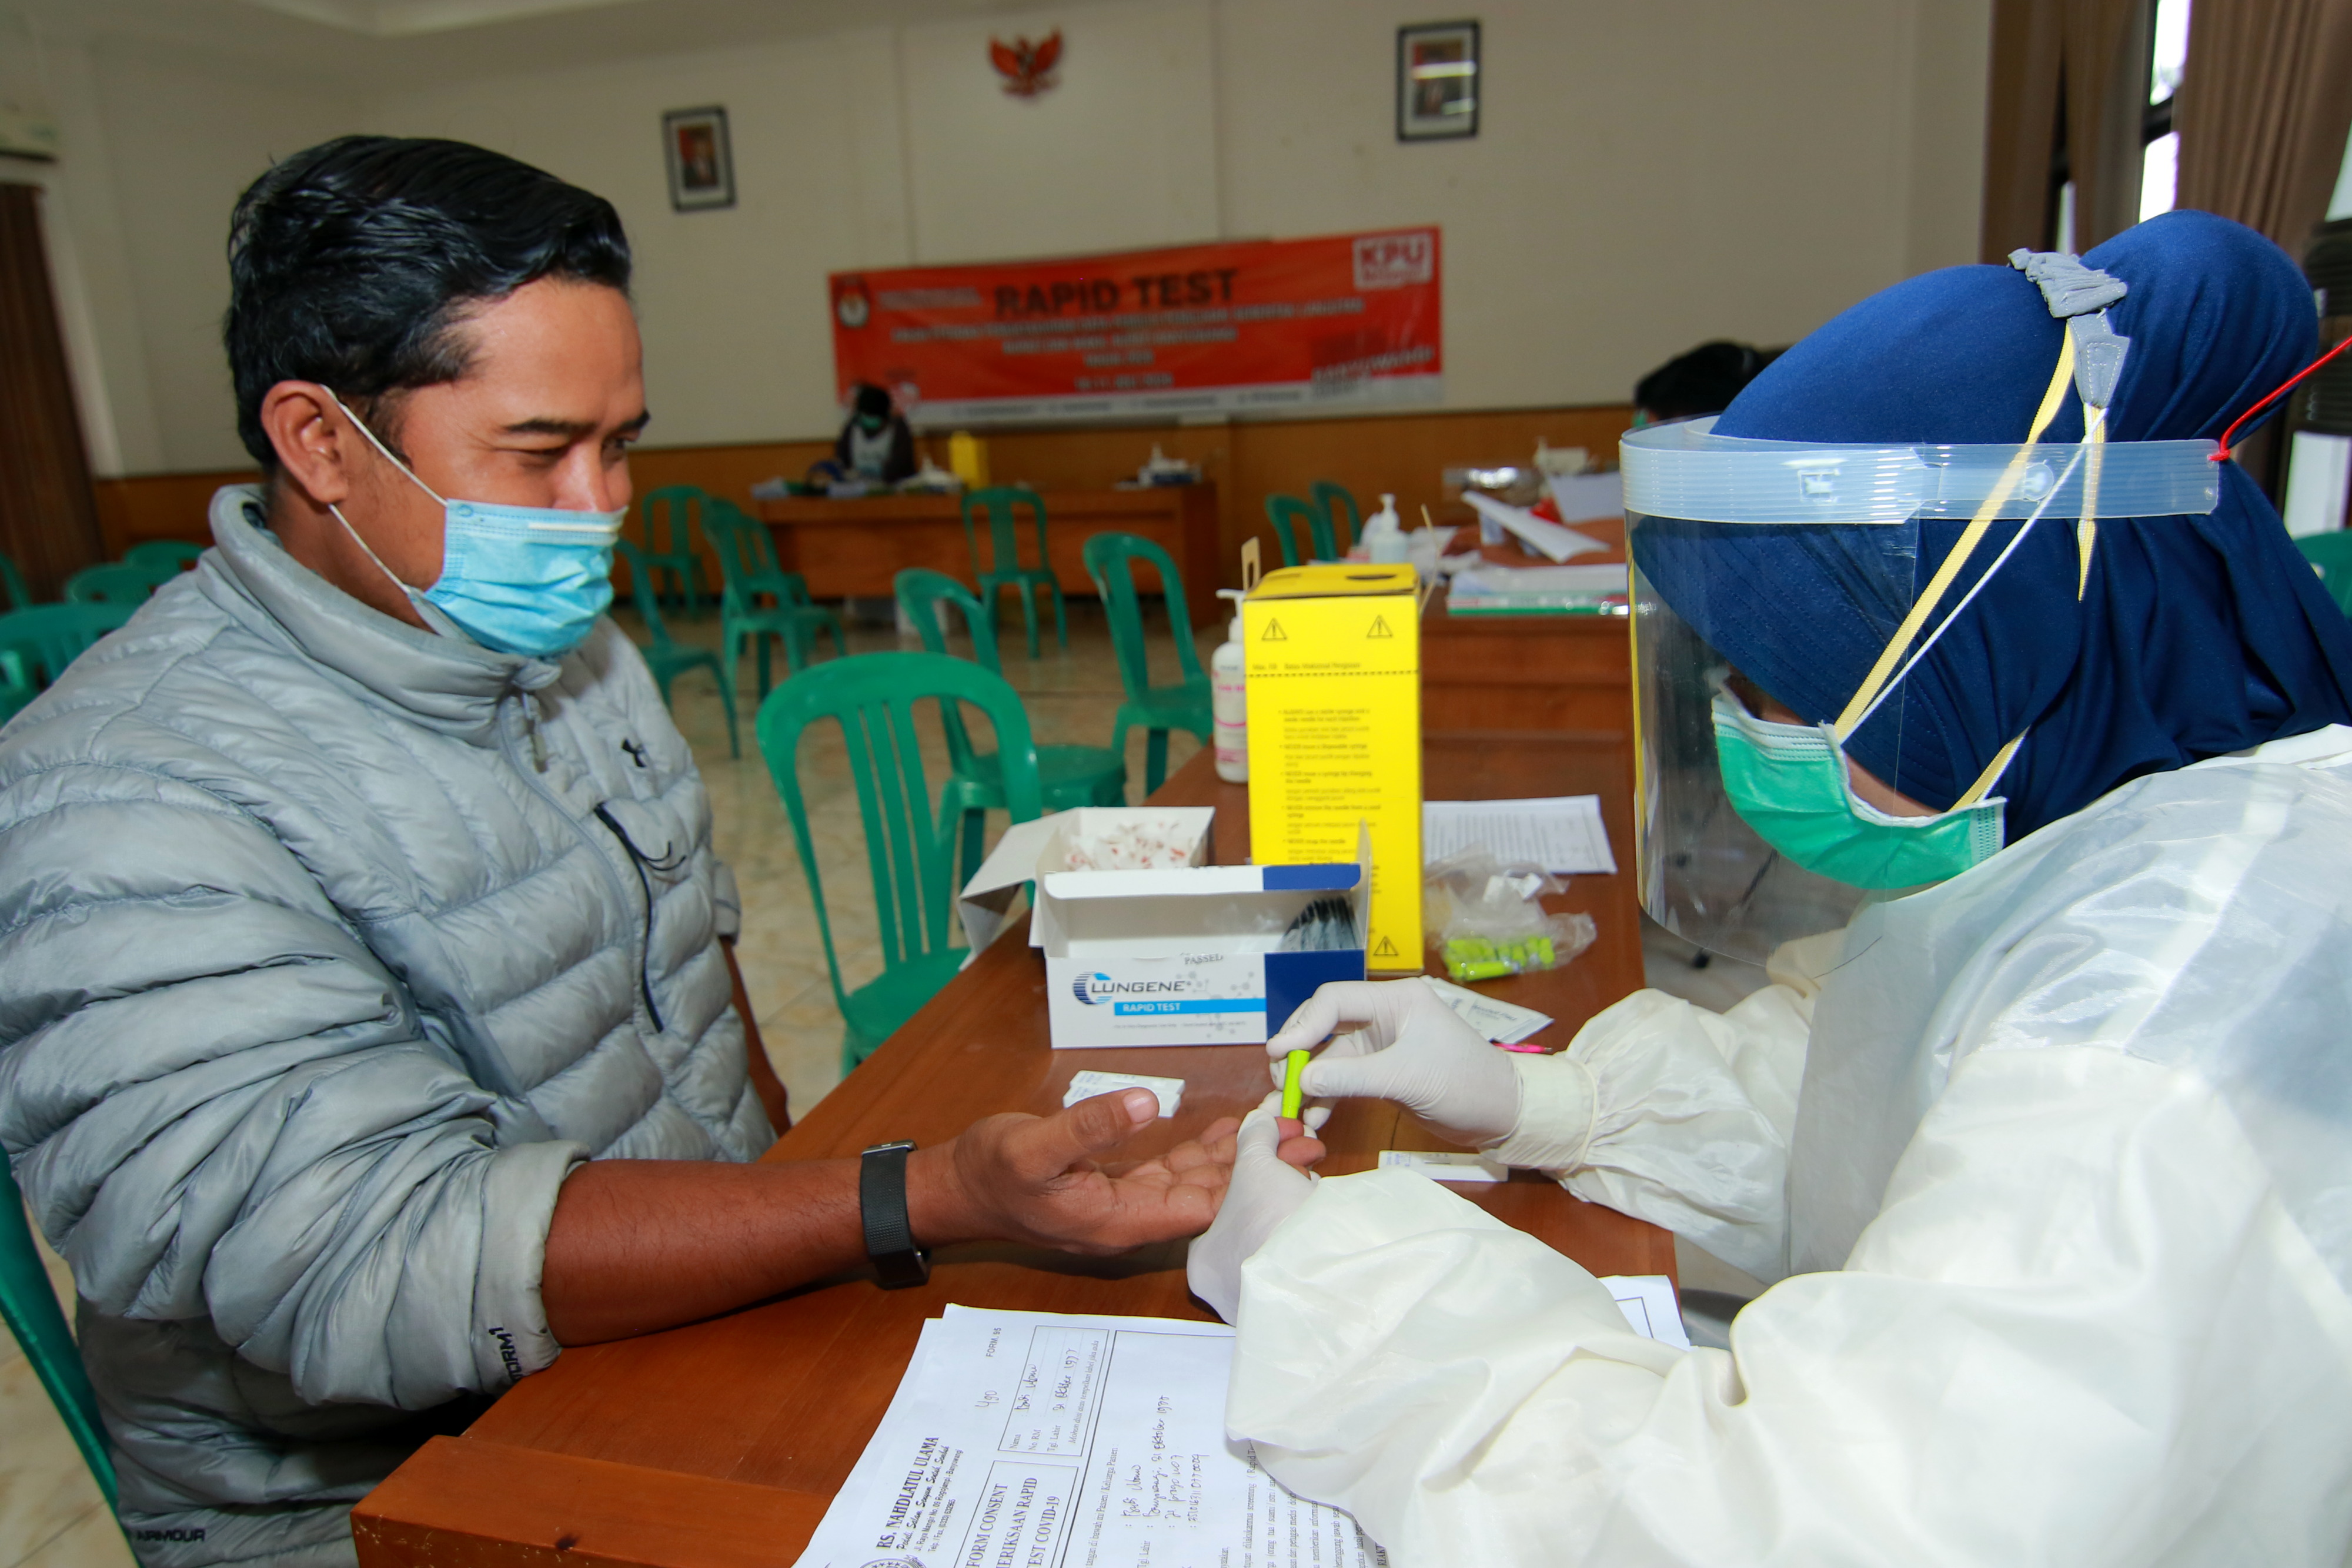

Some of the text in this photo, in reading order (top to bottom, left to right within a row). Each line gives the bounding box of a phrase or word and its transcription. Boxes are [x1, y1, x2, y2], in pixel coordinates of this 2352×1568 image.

[995, 279, 1119, 318] RAPID
[1131, 268, 1238, 306] TEST
[1091, 980, 1186, 993] LUNGENE
[1122, 1002, 1181, 1012] RAPID TEST
[985, 1327, 1002, 1358] FORM. 95
[1088, 1352, 1097, 1362] jika
[1084, 1361, 1095, 1373] label
[1078, 1373, 1093, 1400] tempelkan
[1077, 1400, 1085, 1412] atau
[1072, 1412, 1083, 1423] diisi
[1031, 1429, 1042, 1440] RM
[1049, 1425, 1061, 1440] Lahir
[1068, 1423, 1081, 1444] Mohon
[1009, 1434, 1022, 1449] Nama
[946, 1449, 964, 1474] Banyuwangi
[1106, 1447, 1118, 1466] Pasien
[1246, 1456, 1258, 1473] Rapid
[1100, 1467, 1116, 1490] Keluarga
[875, 1436, 940, 1549] RS. NAHDLATUL ULAMA
[934, 1477, 953, 1501] Rogojampi
[1245, 1483, 1257, 1510] screening
[1267, 1492, 1275, 1502] istri
[928, 1507, 939, 1516] No.
[1096, 1495, 1108, 1513] Pasien
[995, 1477, 1038, 1568] ERIKSAAN RAPID
[1034, 1496, 1060, 1543] COVID-19
[1267, 1507, 1275, 1522] suami
[1287, 1510, 1297, 1526] medis
[921, 1516, 936, 1532] Mangir
[964, 1483, 1008, 1568] FORM CONSENT
[1089, 1522, 1102, 1539] bawah
[1267, 1527, 1275, 1536] tua
[1330, 1520, 1344, 1539] jawab
[916, 1533, 928, 1544] Raya
[1288, 1526, 1299, 1547] petugas
[1309, 1529, 1319, 1561] memberikan
[1353, 1537, 1364, 1549] hasil
[1085, 1547, 1097, 1566] tangan
[1138, 1540, 1151, 1556] Lahir
[1264, 1540, 1277, 1557] (orang
[1287, 1548, 1297, 1558] dari
[1332, 1538, 1344, 1568] bertanggung
[1375, 1542, 1387, 1566] REAKT
